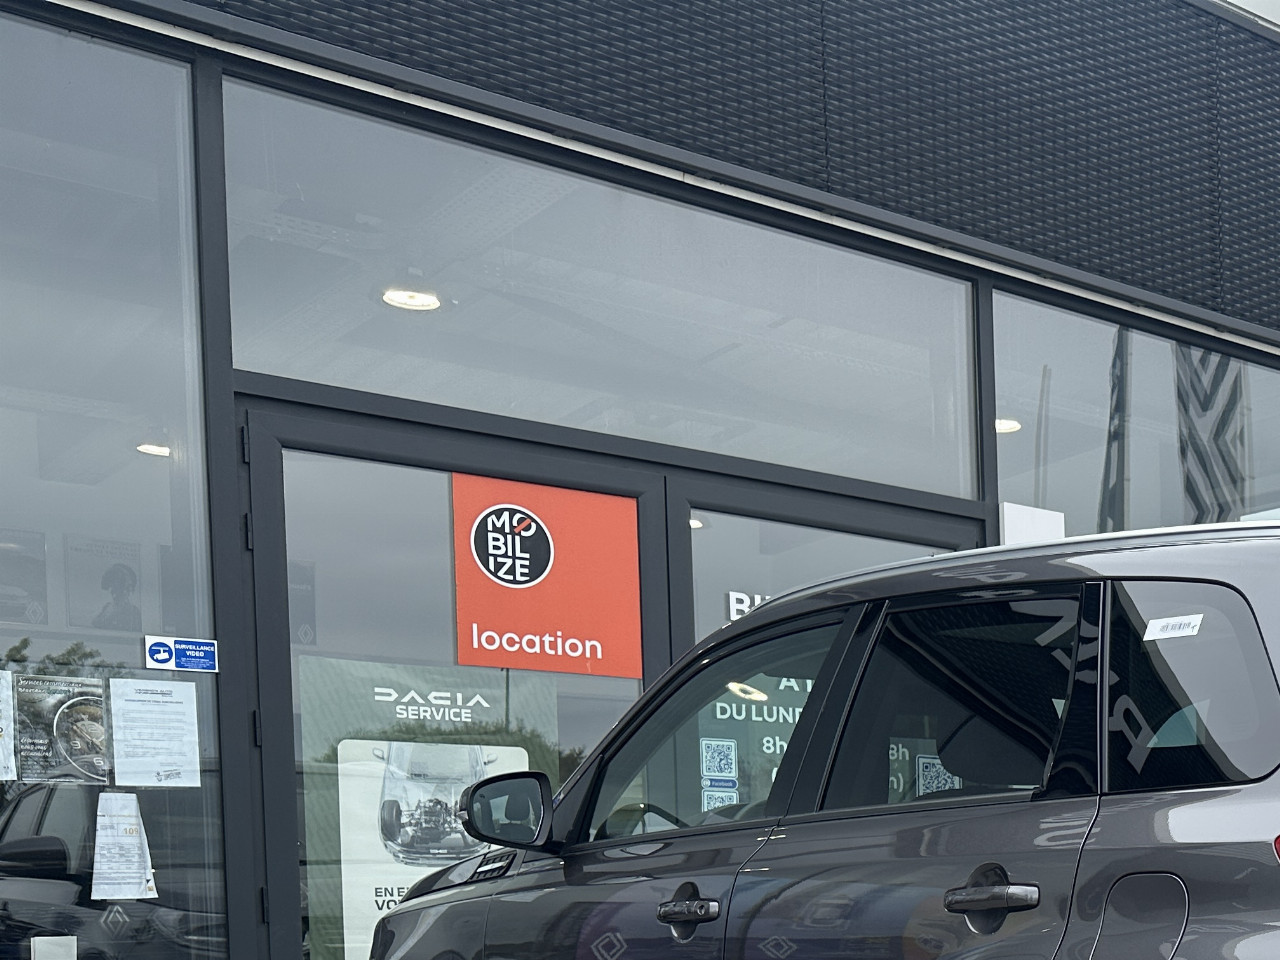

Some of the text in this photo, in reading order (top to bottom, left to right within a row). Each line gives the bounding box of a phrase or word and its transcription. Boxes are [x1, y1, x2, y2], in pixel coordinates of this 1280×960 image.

[174, 643, 215, 652] SURVEILLANCE
[472, 622, 603, 659] location
[374, 687, 491, 708] DACIA
[395, 705, 472, 722] SERVICE
[716, 702, 746, 720] DU
[374, 887, 394, 898] EN
